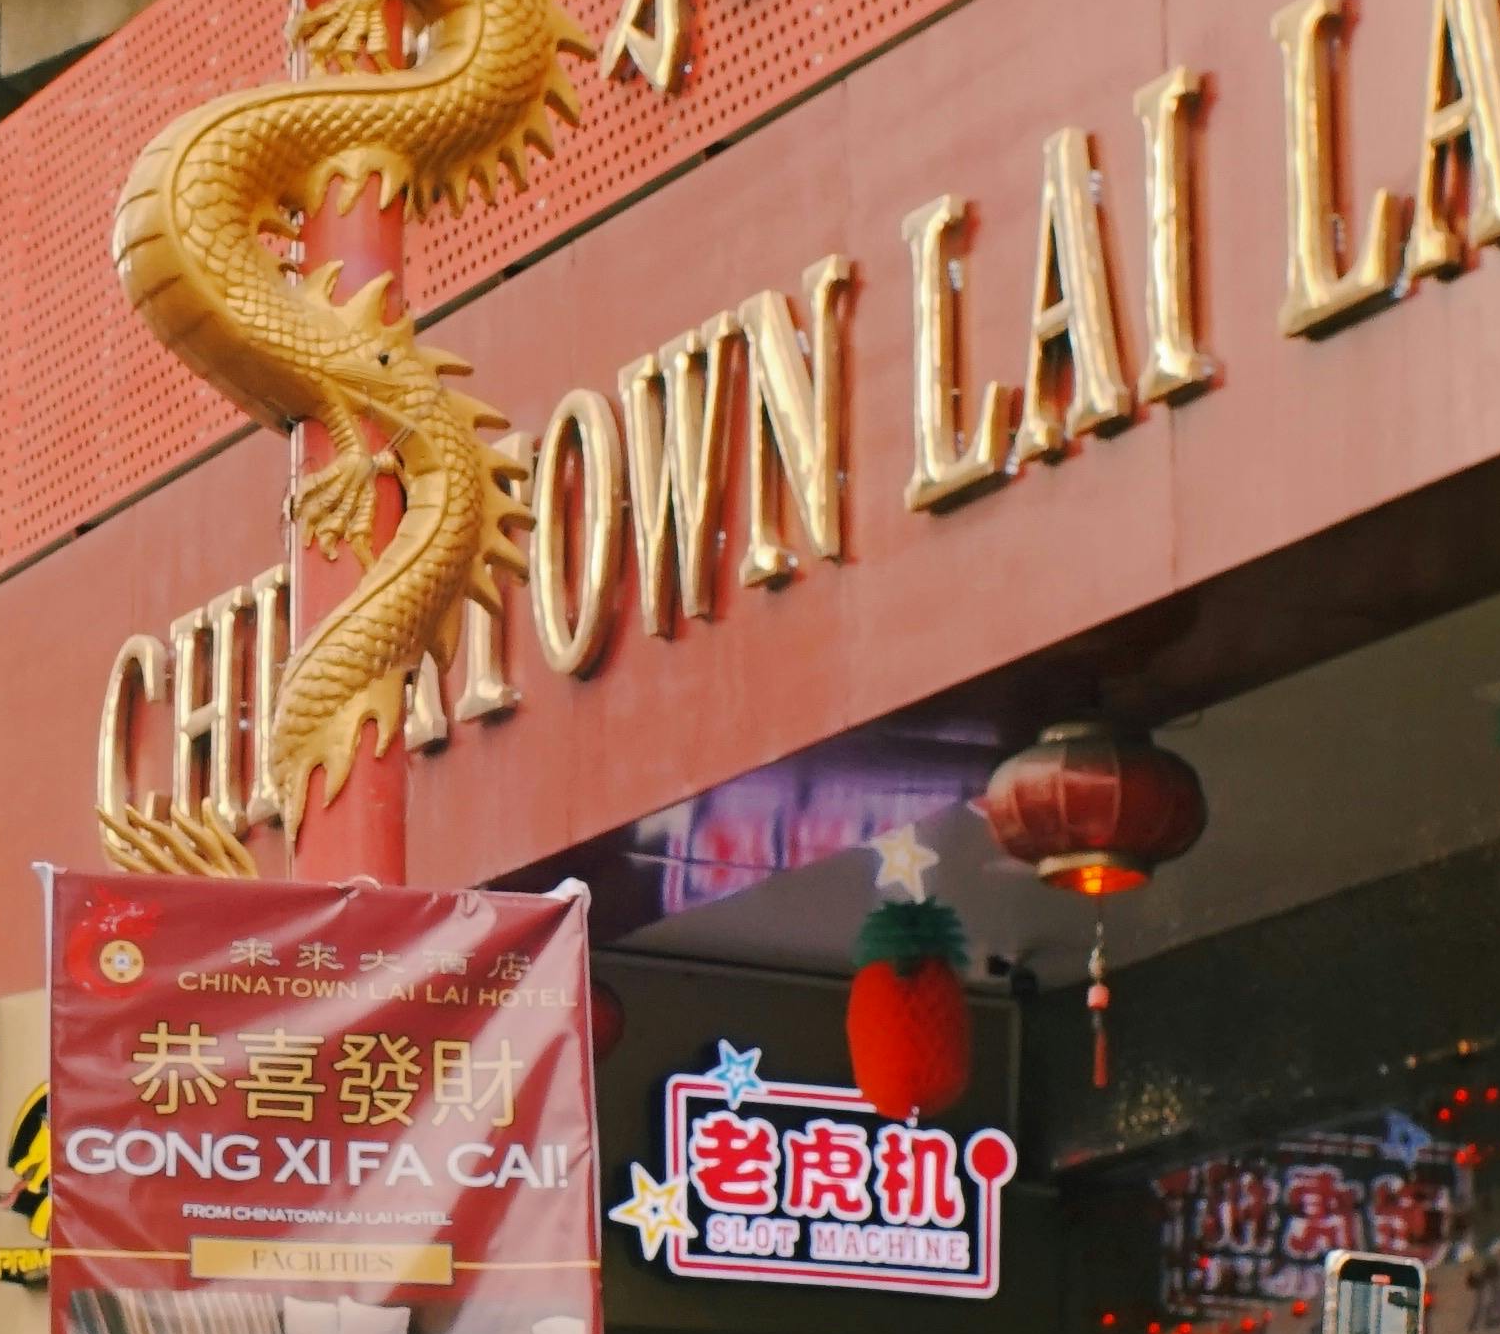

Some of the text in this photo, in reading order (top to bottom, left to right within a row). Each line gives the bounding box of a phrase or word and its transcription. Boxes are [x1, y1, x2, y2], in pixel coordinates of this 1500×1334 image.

[98, 253, 852, 857] CHITOWN
[902, 64, 1215, 511] LAI
[177, 971, 578, 1009] CHINATOWN LAI LAI HOTEL
[131, 1022, 524, 1128] 恭喜發財
[66, 1128, 570, 1190] GONG XI FA CAI!
[692, 1113, 961, 1224] 老虎机
[182, 1202, 231, 1220] FROM
[232, 1205, 333, 1224] CHINATOWN
[252, 1248, 394, 1273] FACILITIES
[708, 1216, 969, 1268] SLOT MACHINE
